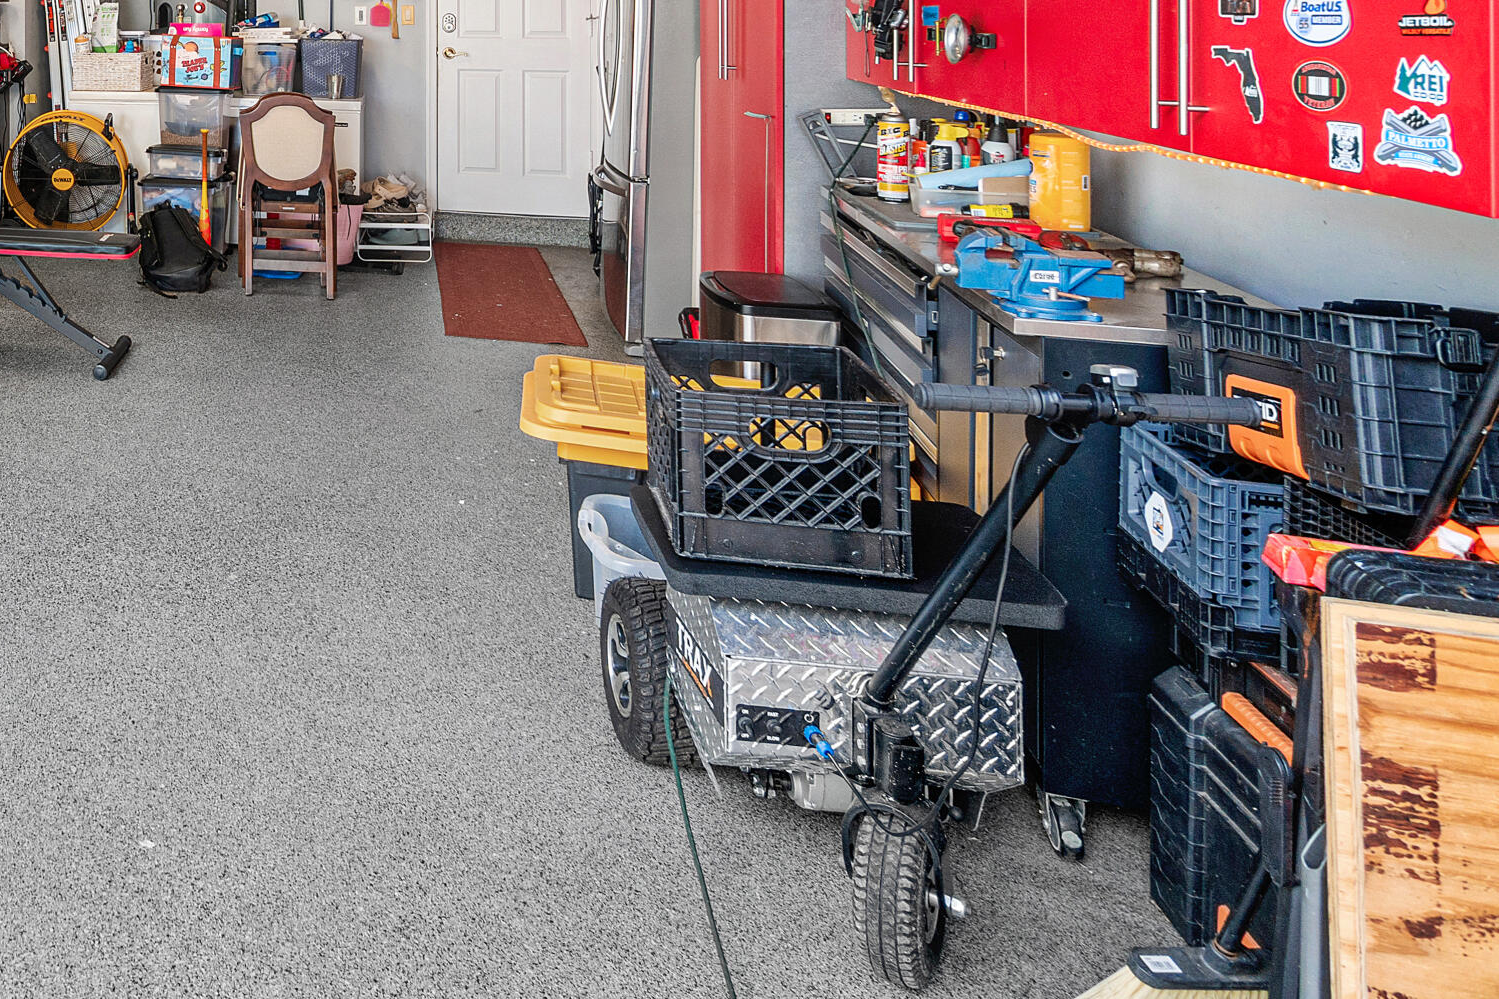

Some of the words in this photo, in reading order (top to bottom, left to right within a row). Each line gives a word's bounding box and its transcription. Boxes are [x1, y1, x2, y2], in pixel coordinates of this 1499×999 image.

[1399, 16, 1454, 27] JETBOIL
[182, 57, 207, 67] TRADER
[1413, 73, 1444, 93] REI
[1387, 130, 1446, 149] PALMETTO
[676, 617, 713, 698] TRAX
